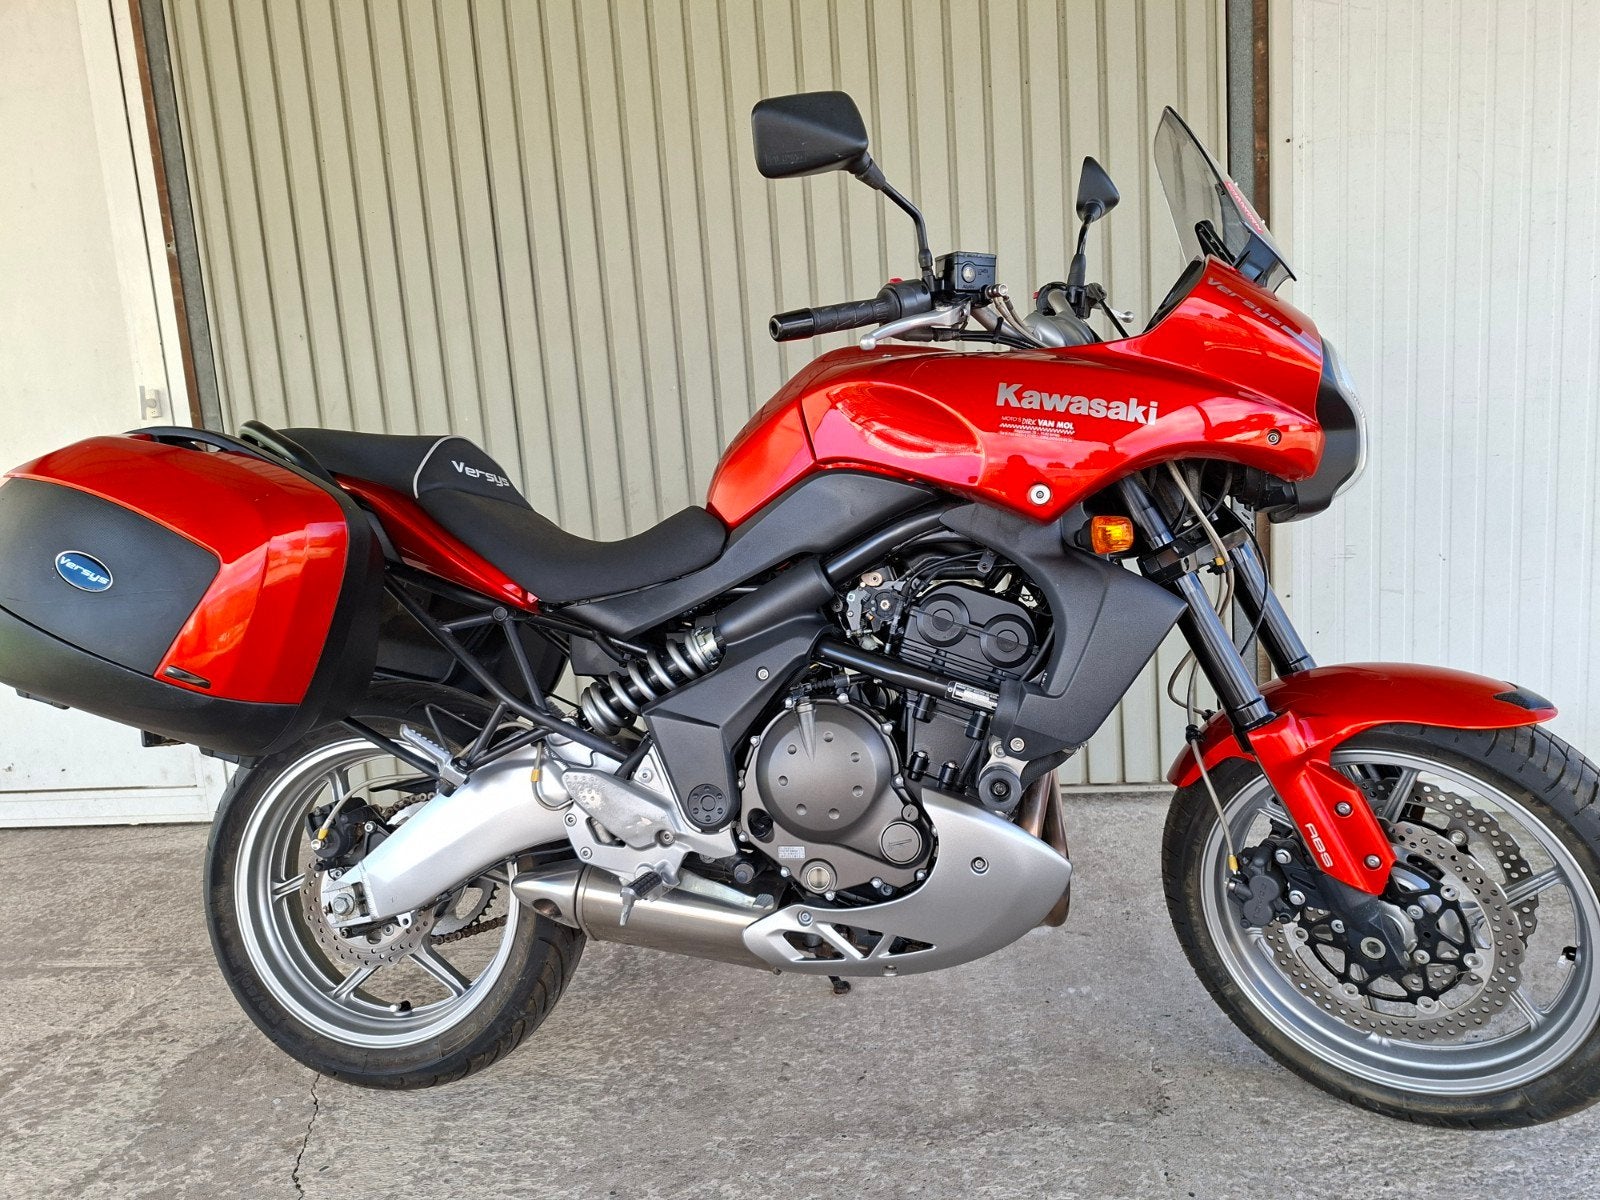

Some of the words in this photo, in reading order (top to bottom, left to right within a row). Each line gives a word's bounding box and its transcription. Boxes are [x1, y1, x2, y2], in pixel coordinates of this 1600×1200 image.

[1207, 277, 1282, 326] Versys
[996, 382, 1158, 426] Kawasaki
[1021, 417, 1036, 426] DIRK
[1037, 418, 1055, 428] VAN
[1056, 420, 1075, 430] MOL
[451, 460, 510, 487] Versys
[60, 556, 110, 585] Versys
[1304, 822, 1334, 868] ABS
